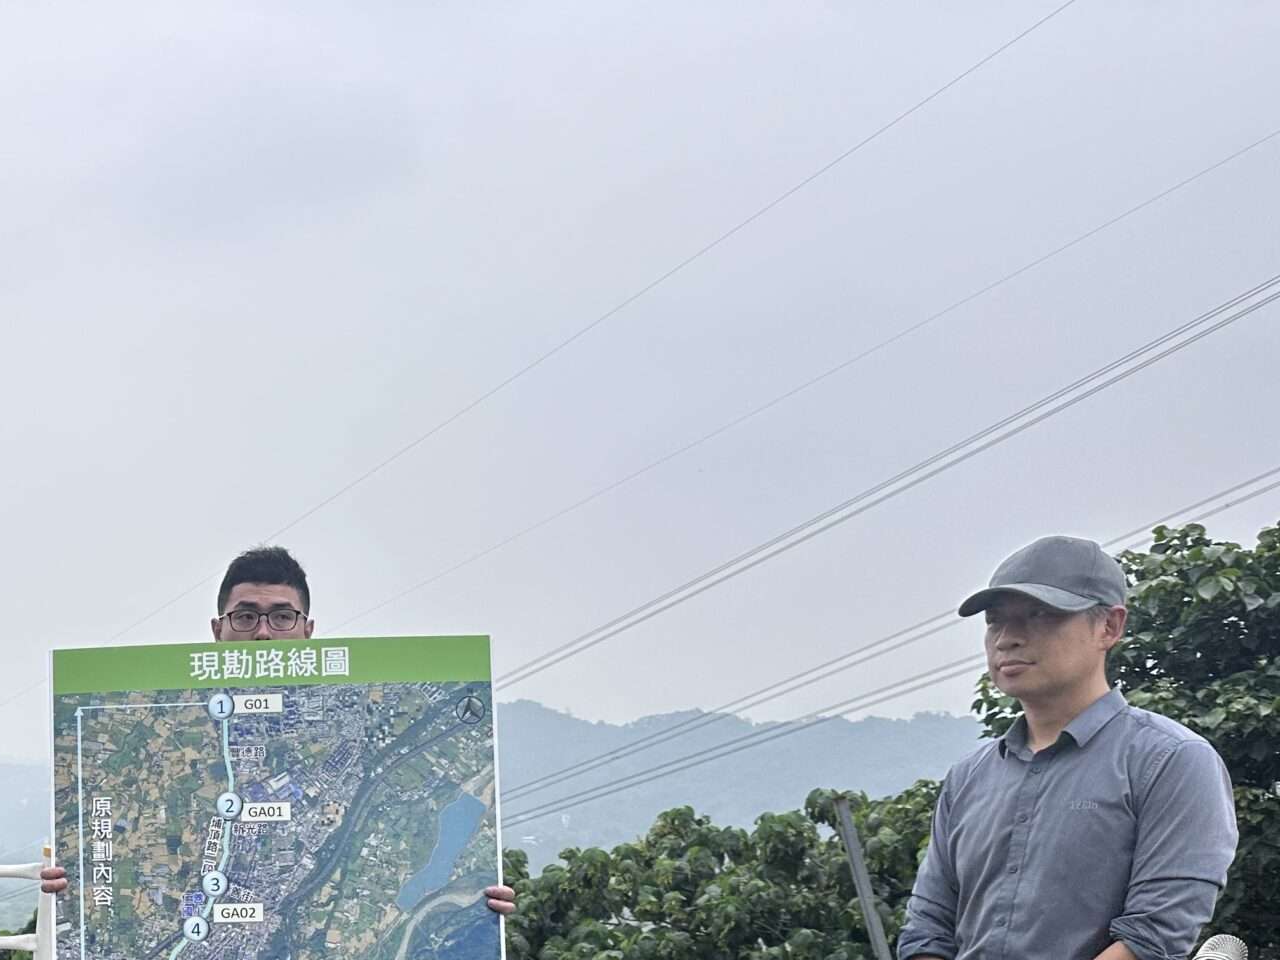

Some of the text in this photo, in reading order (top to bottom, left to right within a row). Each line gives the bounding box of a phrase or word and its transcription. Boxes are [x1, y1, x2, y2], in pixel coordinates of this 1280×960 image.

[190, 646, 350, 680] 現勘路線圖
[216, 700, 226, 714] 1
[244, 698, 269, 711] G01
[225, 799, 234, 813] 2
[248, 806, 283, 818] GA01
[91, 796, 113, 906] 原規劃內容
[211, 878, 221, 891] 3
[221, 907, 256, 919] GA02
[191, 923, 201, 937] 4
